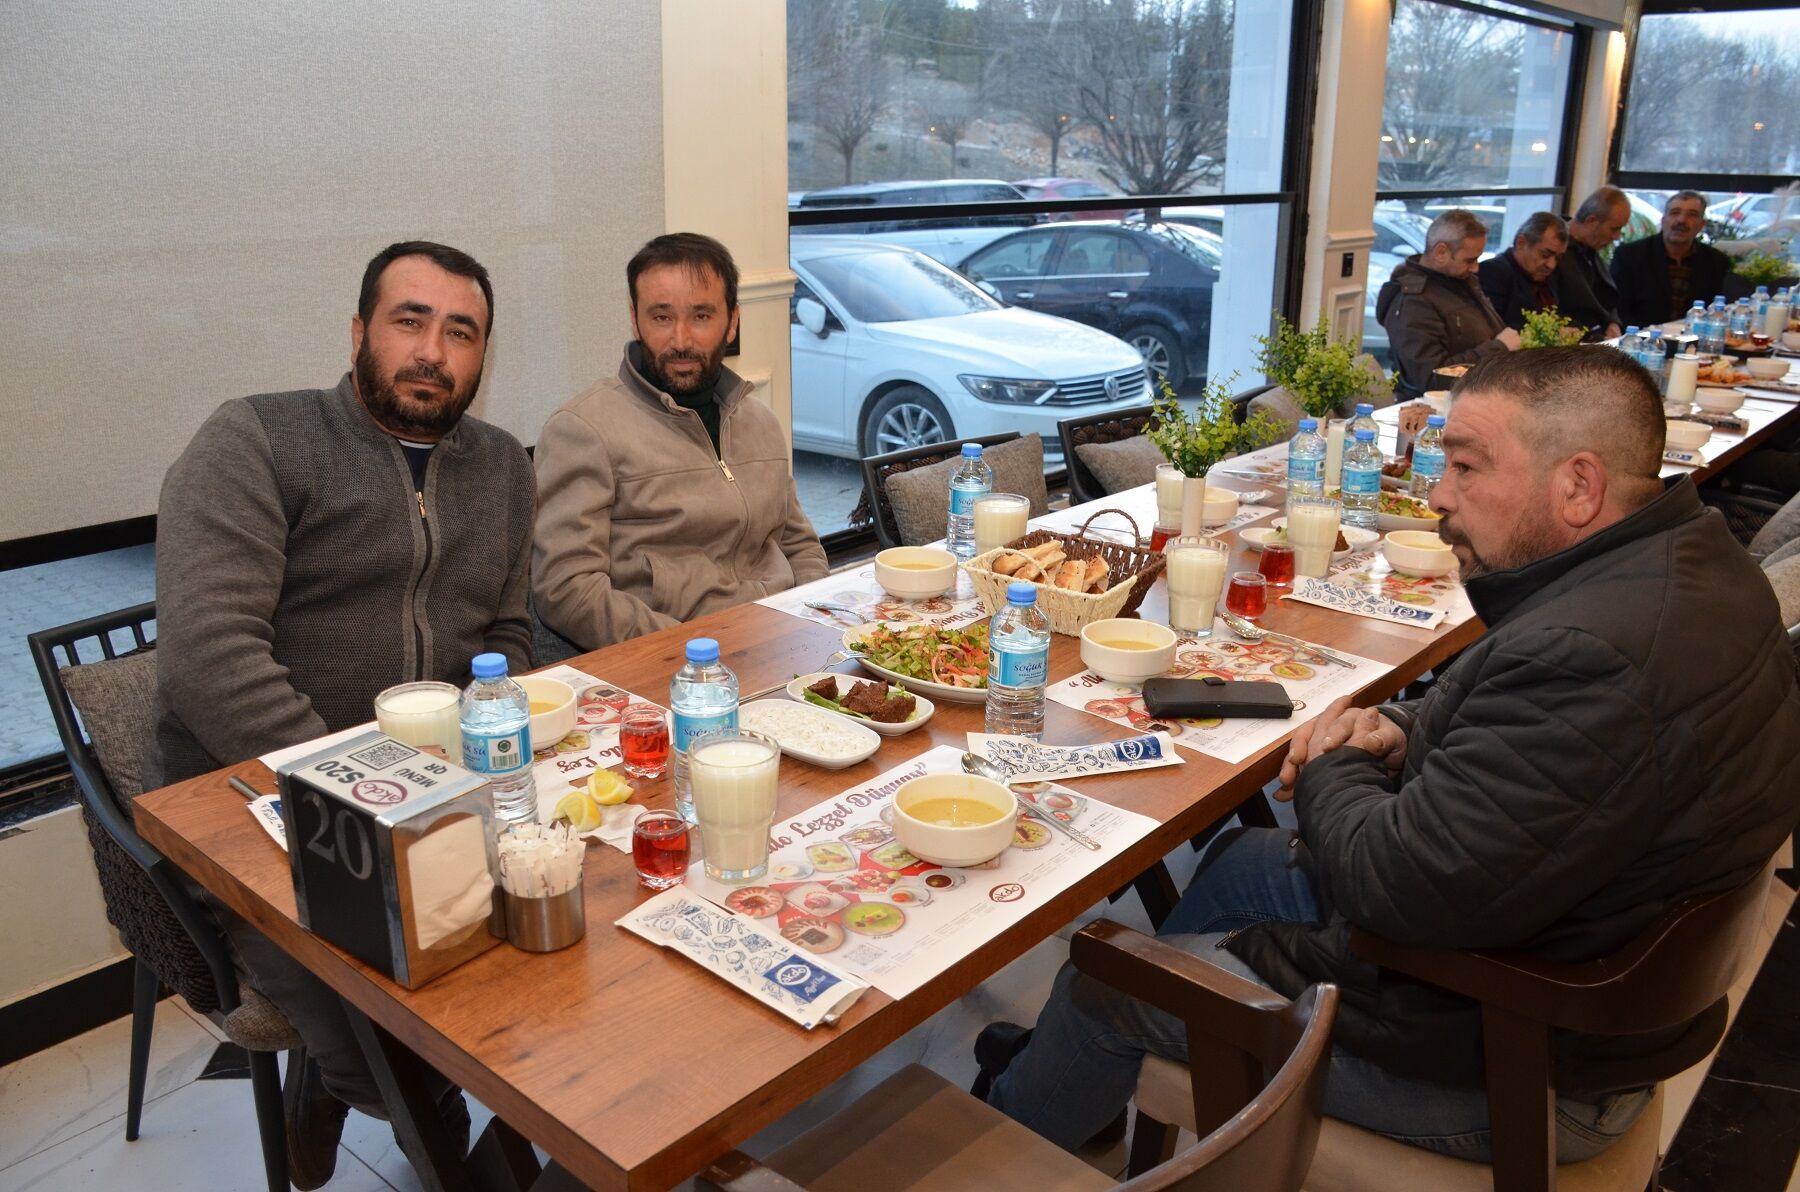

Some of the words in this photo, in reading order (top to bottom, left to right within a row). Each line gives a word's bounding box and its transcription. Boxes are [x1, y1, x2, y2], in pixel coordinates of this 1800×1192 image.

[314, 760, 365, 784] S20
[393, 767, 438, 788] MENÜ
[424, 762, 448, 776] QR
[360, 782, 404, 803] akdo
[789, 802, 854, 838] Lezzet
[302, 790, 373, 880] 20
[993, 883, 1021, 902] akdo
[780, 965, 808, 984] akdo
